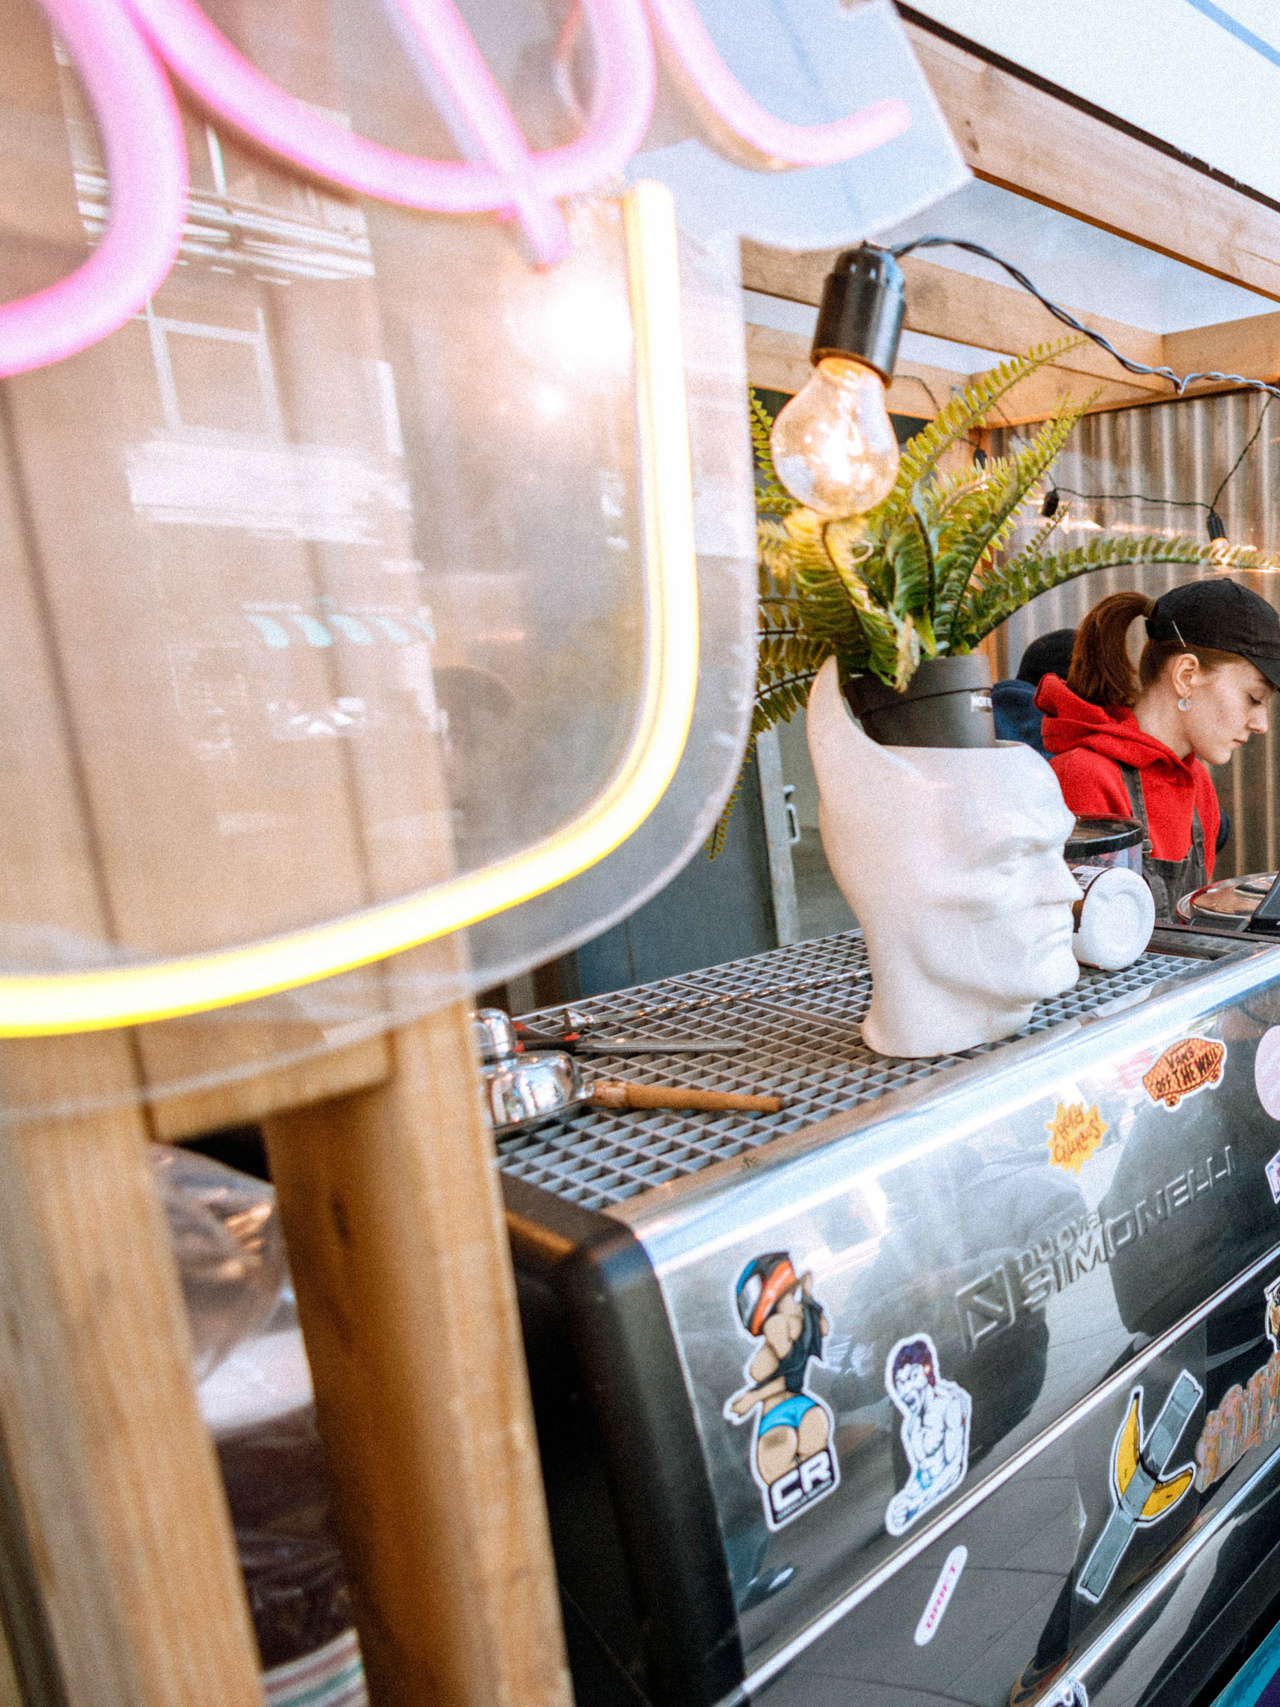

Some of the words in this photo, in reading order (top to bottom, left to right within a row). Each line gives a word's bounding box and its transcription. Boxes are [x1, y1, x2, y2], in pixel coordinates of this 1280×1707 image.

[1163, 1043, 1195, 1069] VANS
[1155, 1073, 1172, 1093] OFF
[1172, 1063, 1197, 1088] THE
[770, 1450, 832, 1512] CR
